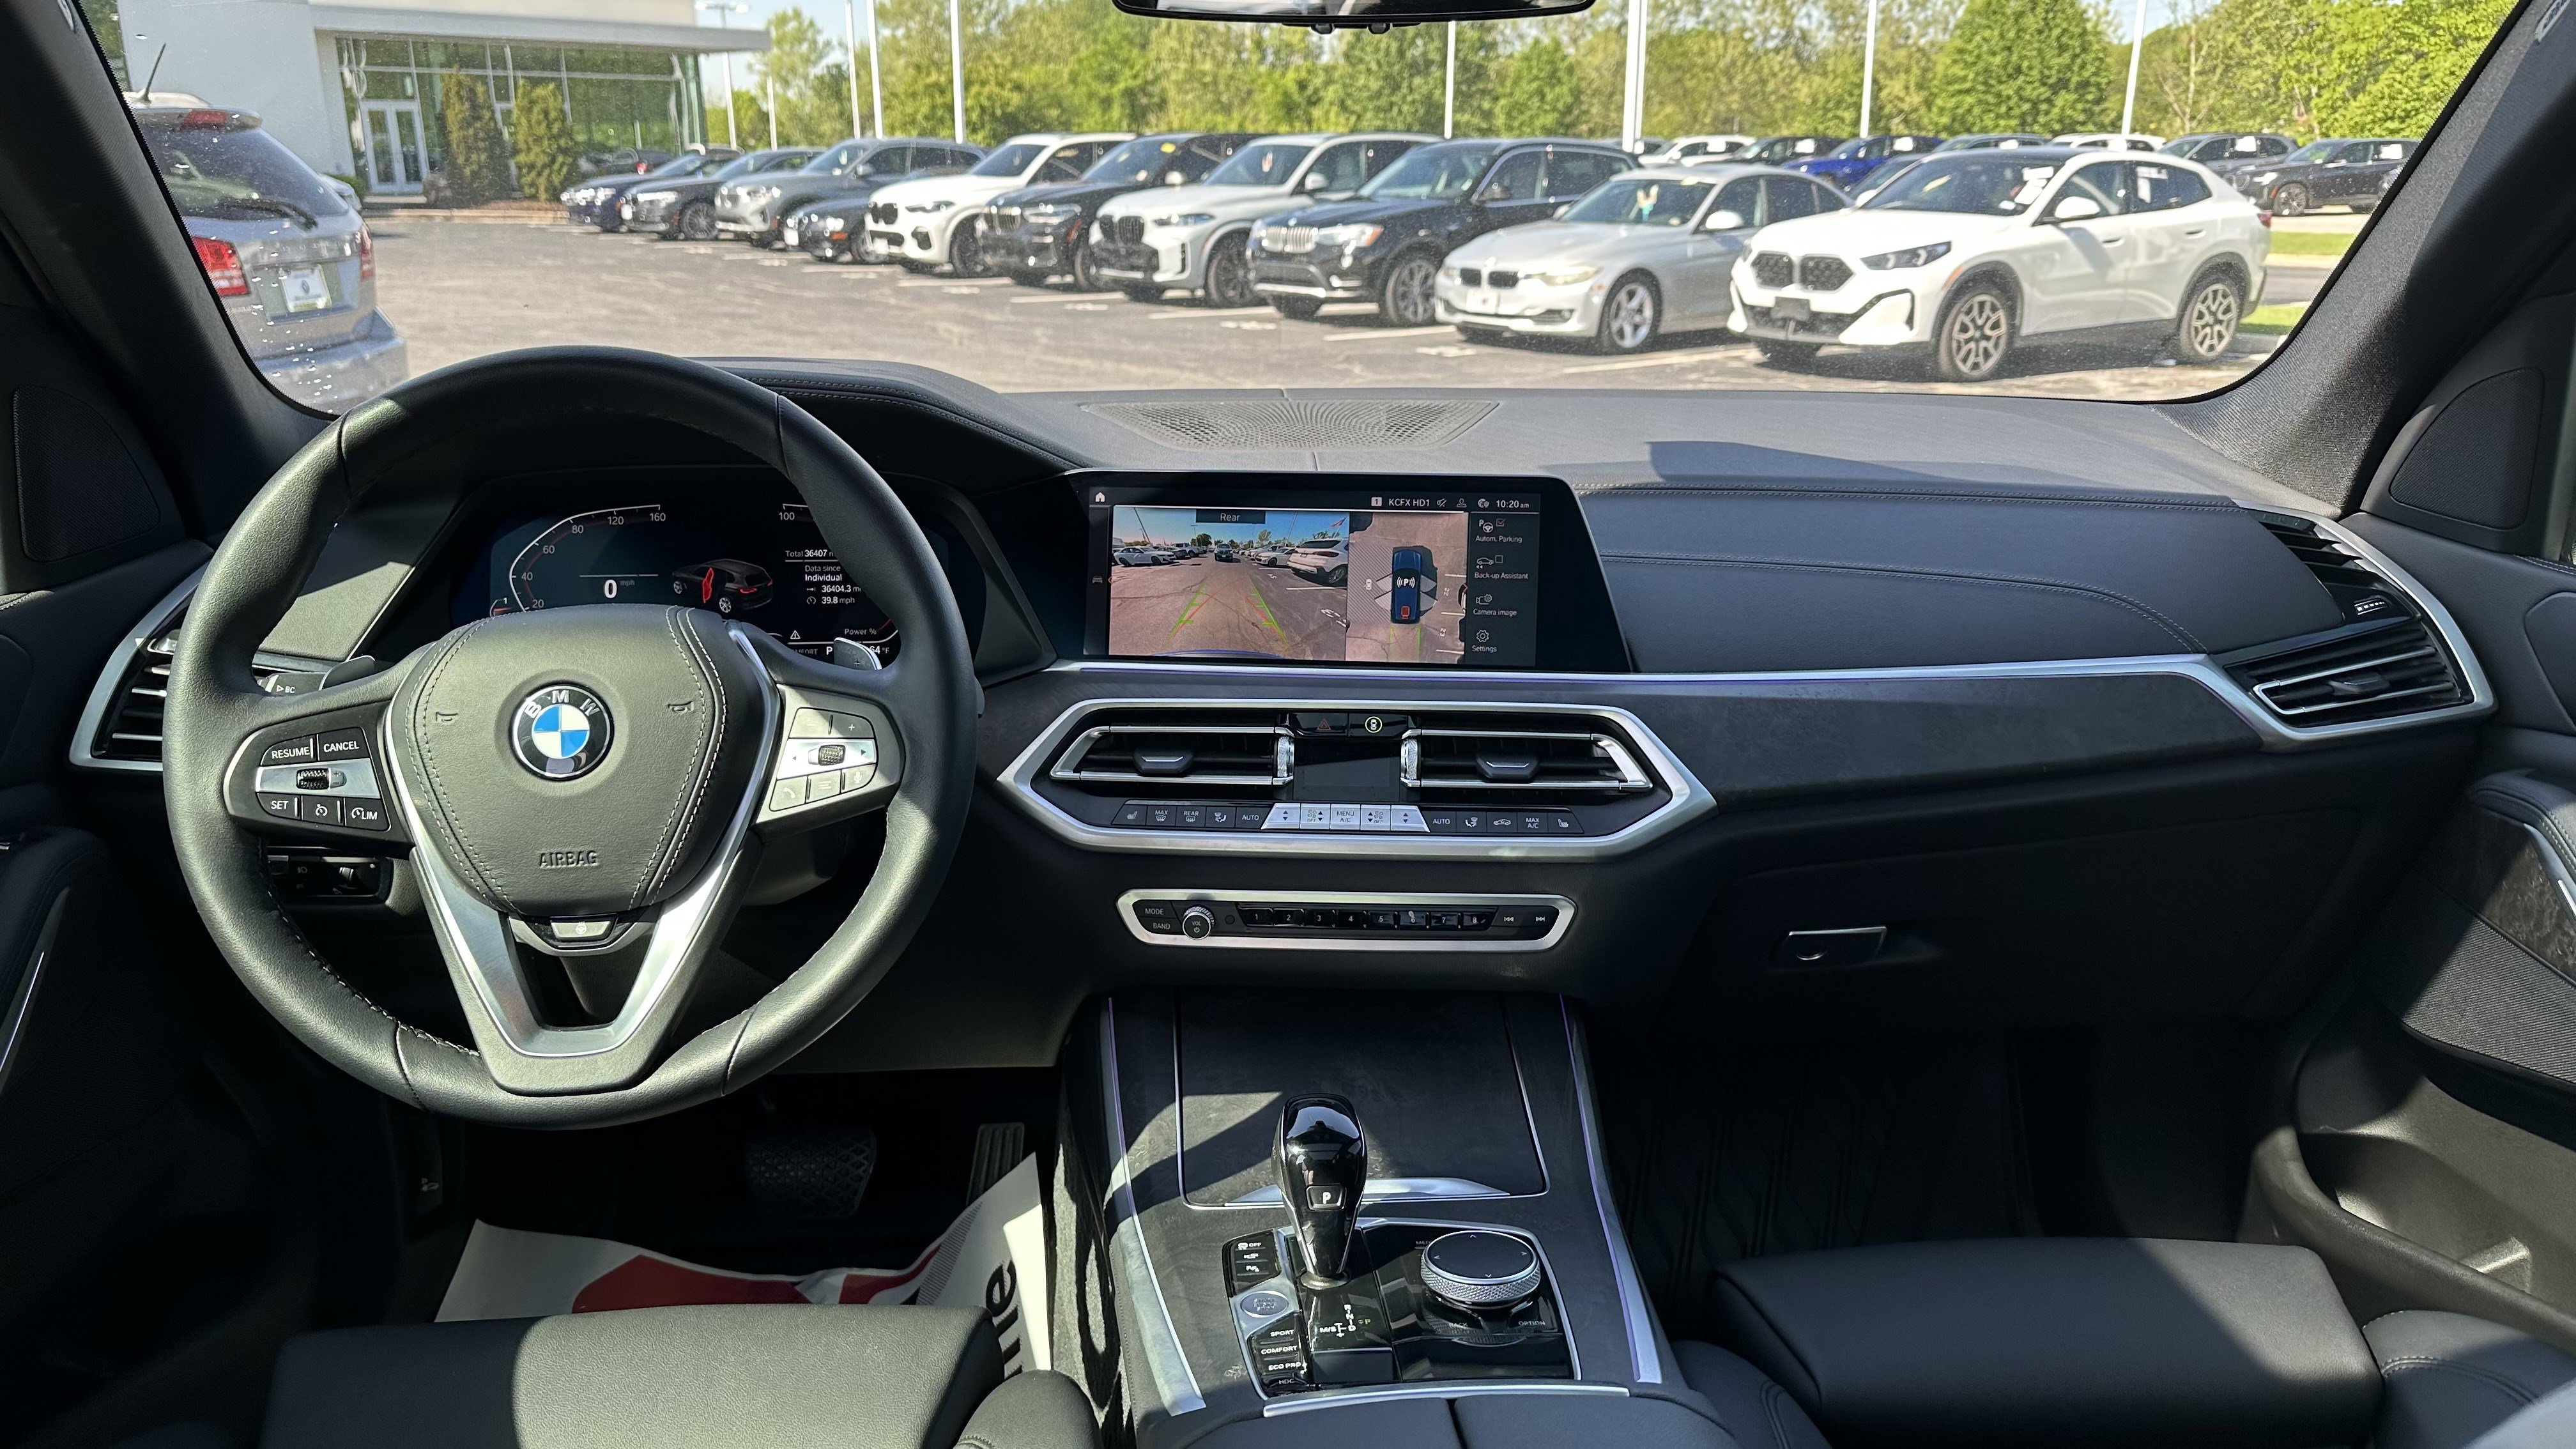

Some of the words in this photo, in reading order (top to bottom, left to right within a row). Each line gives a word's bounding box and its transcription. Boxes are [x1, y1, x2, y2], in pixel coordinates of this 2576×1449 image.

[1388, 498, 1411, 507] KCFX
[1413, 498, 1430, 507] HD1
[1496, 500, 1519, 509] 10:20
[608, 516, 624, 525] 120
[649, 512, 666, 522] 160
[778, 512, 795, 521] 100
[1220, 513, 1240, 522] Rear
[572, 525, 584, 534] 80
[543, 545, 555, 554] 60
[521, 572, 533, 581] 40
[604, 579, 617, 599] 0
[620, 579, 635, 588] mph
[821, 585, 852, 593] 36404.3
[532, 599, 544, 608] 20
[821, 596, 838, 604] 39.8
[839, 597, 855, 605] mph
[825, 646, 833, 656] P
[870, 645, 881, 654] 64
[284, 686, 295, 694] BC
[323, 740, 360, 753] CANCEL
[272, 746, 310, 760] RESUME
[270, 801, 289, 809] SET
[361, 811, 378, 820] LIM
[539, 850, 599, 868] AIRBAG
[1322, 1192, 1331, 1204] P
[1261, 1345, 1298, 1354] COMFORT
